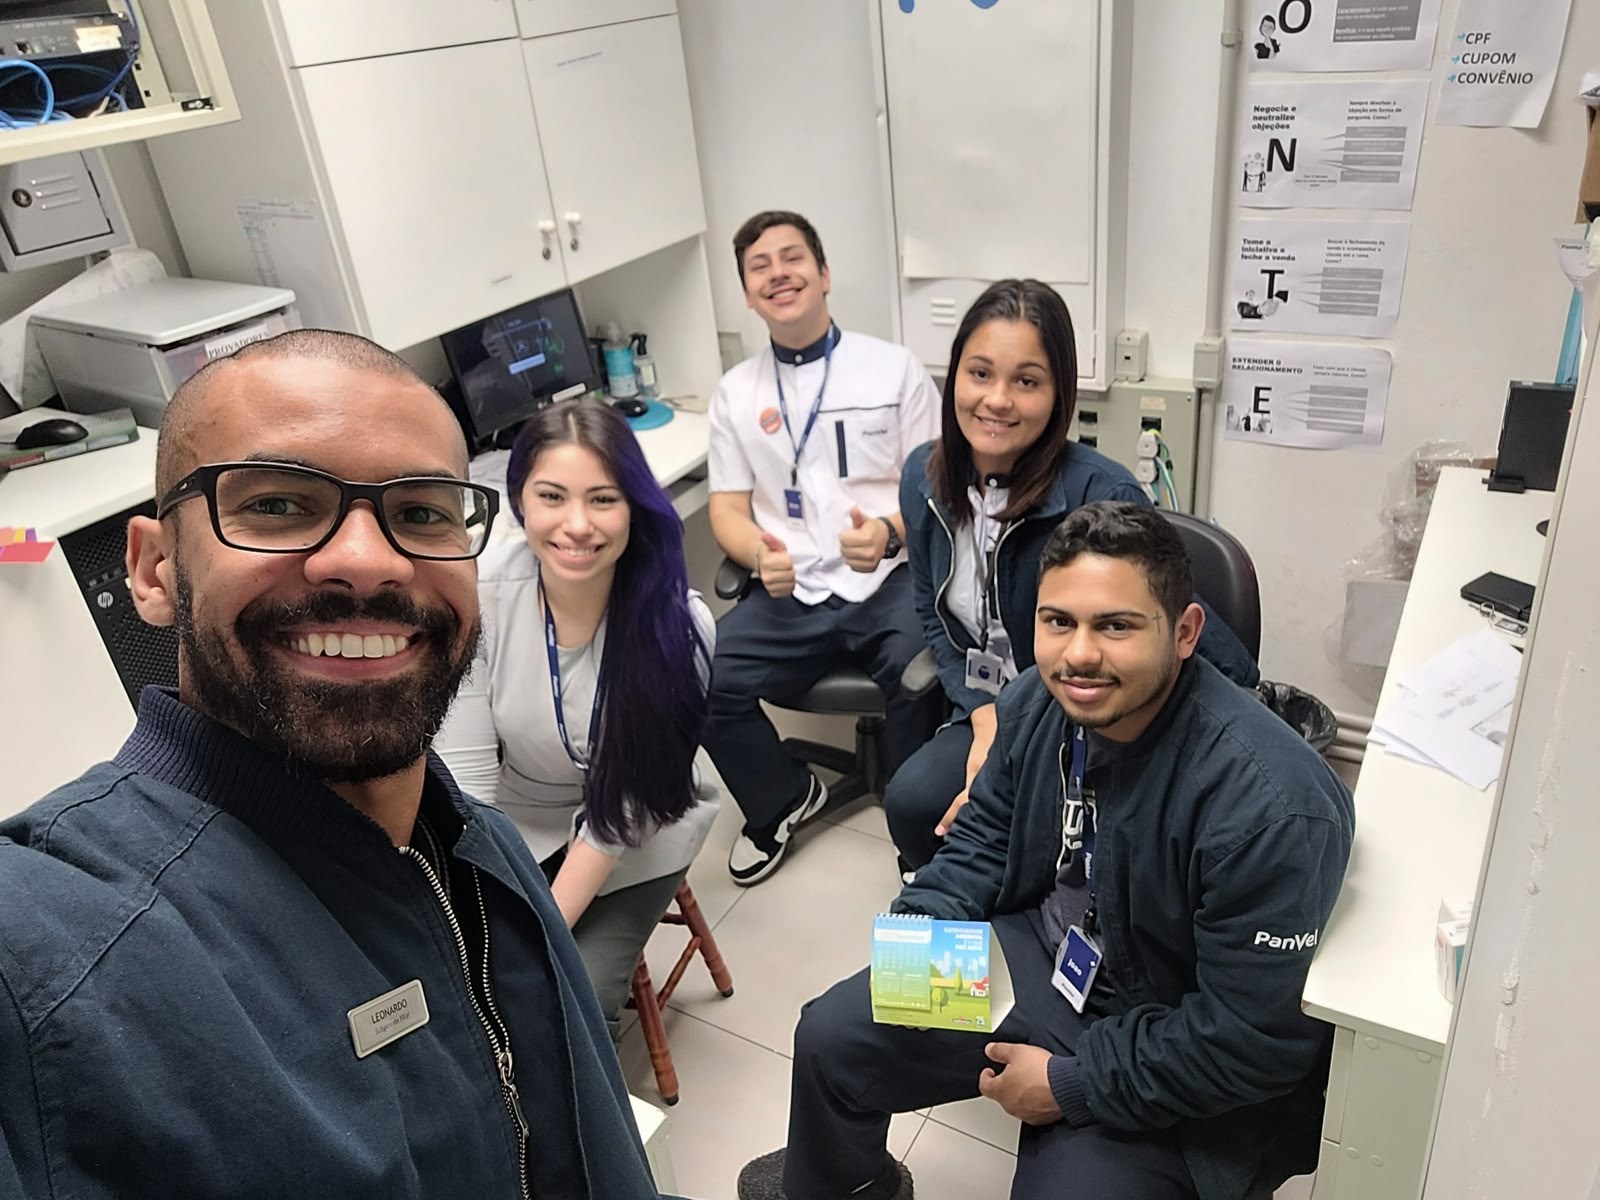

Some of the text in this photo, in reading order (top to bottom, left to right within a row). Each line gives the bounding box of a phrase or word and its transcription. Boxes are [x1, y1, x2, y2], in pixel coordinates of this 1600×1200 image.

[1279, 0, 1312, 33] O
[1466, 32, 1492, 44] CPF
[1461, 52, 1516, 64] CUPOM
[1457, 69, 1534, 84] CONVÊNIO
[1254, 104, 1289, 114] Negocie
[1252, 122, 1290, 131] objeções
[1266, 138, 1297, 172] N
[1260, 269, 1285, 300] T
[1232, 357, 1274, 366] ESTENDER
[1232, 364, 1302, 374] RELACIONAMENTO
[1253, 386, 1272, 414] E
[371, 998, 408, 1024] LEONARDO
